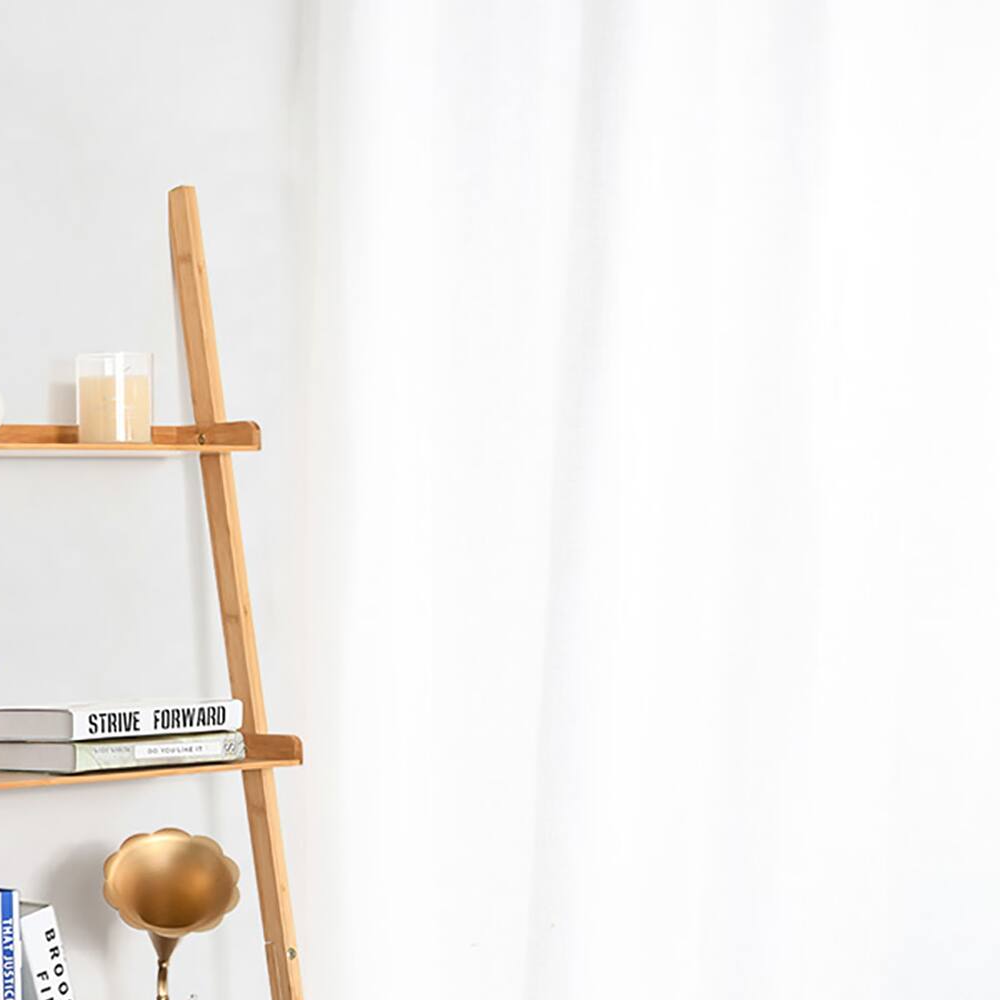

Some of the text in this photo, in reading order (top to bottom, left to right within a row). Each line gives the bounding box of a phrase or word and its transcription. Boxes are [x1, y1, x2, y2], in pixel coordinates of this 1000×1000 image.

[88, 706, 226, 734] STRIVE FORWARD
[2, 918, 14, 951] THAT
